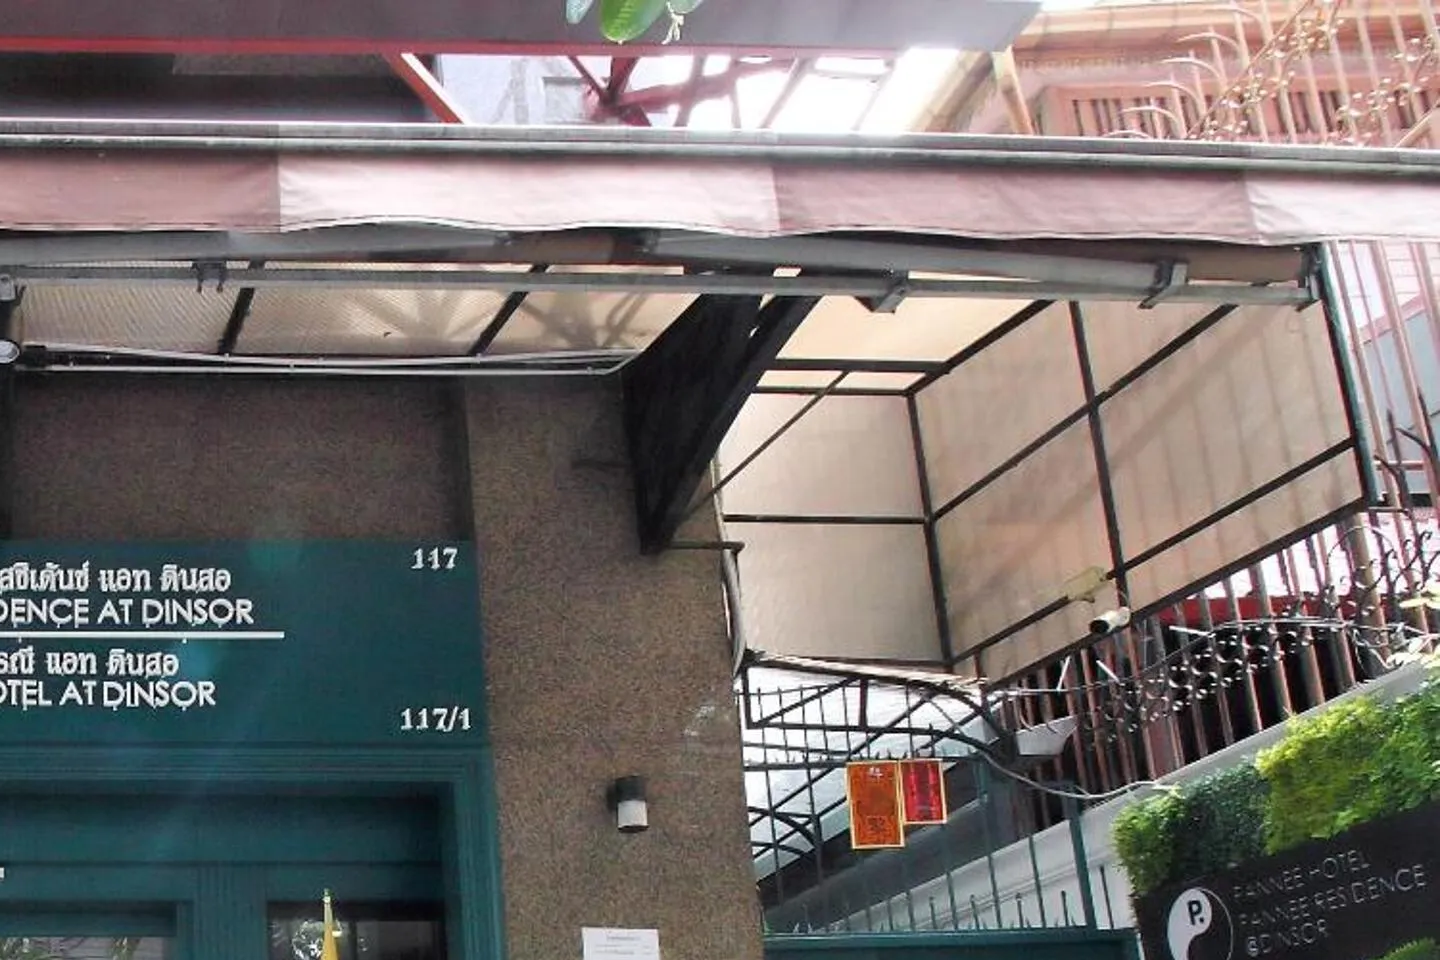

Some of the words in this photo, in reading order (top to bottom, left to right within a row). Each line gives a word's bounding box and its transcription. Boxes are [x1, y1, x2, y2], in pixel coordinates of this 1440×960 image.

[411, 547, 458, 570] 117
[99, 568, 151, 592] แอท
[161, 563, 232, 592] ดินสอ
[97, 599, 133, 625] AT
[142, 599, 254, 626] DINSOR
[46, 650, 97, 676] แอท
[107, 649, 179, 676] ดินสอ
[60, 680, 97, 706] AT
[103, 680, 216, 707] DINSOR
[400, 706, 471, 732] 117/1
[1314, 864, 1427, 910] RESDENCE
[1247, 918, 1329, 957] @DNSOR
